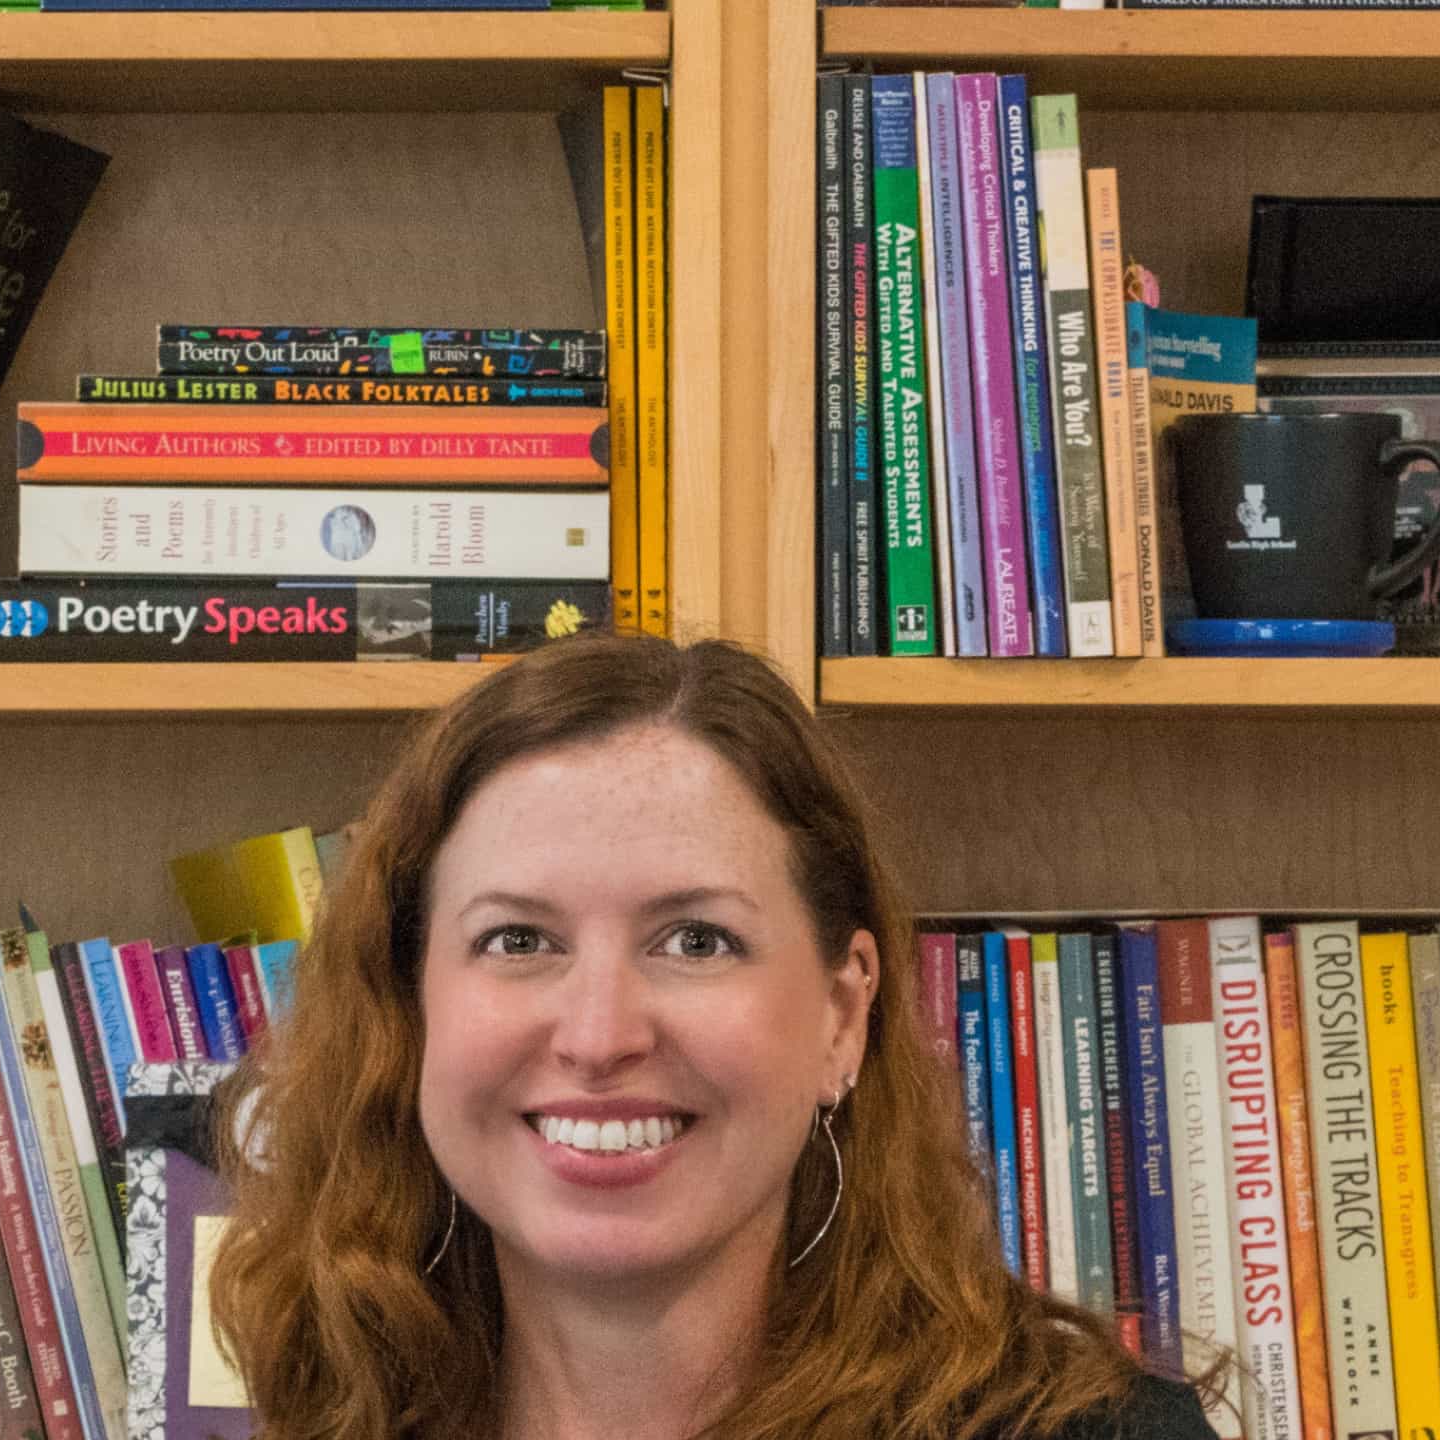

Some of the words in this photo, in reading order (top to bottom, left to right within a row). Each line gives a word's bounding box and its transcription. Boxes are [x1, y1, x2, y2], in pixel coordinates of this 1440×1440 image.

[178, 341, 240, 364] Poetry
[246, 343, 283, 363] Out
[288, 341, 340, 364] Loud
[91, 378, 166, 399] JULIUS
[177, 379, 257, 400] LESTER
[275, 381, 351, 401] BLACK
[361, 381, 490, 402] FOLKTALES
[71, 433, 147, 455] LIVING
[155, 433, 261, 456] AUTHORS
[305, 438, 381, 456] EDITED
[389, 438, 412, 456] BY
[422, 438, 476, 457] DILLY
[486, 438, 553, 457] TANTE
[58, 597, 199, 642] Poetry
[205, 597, 347, 642] Speaks
[1313, 934, 1362, 1080] CROSSING
[1221, 980, 1272, 1201] DISRUPTING
[1325, 1086, 1368, 1147] THE
[1330, 1150, 1376, 1262] TRACKS
[1239, 1218, 1284, 1326] CLASS
